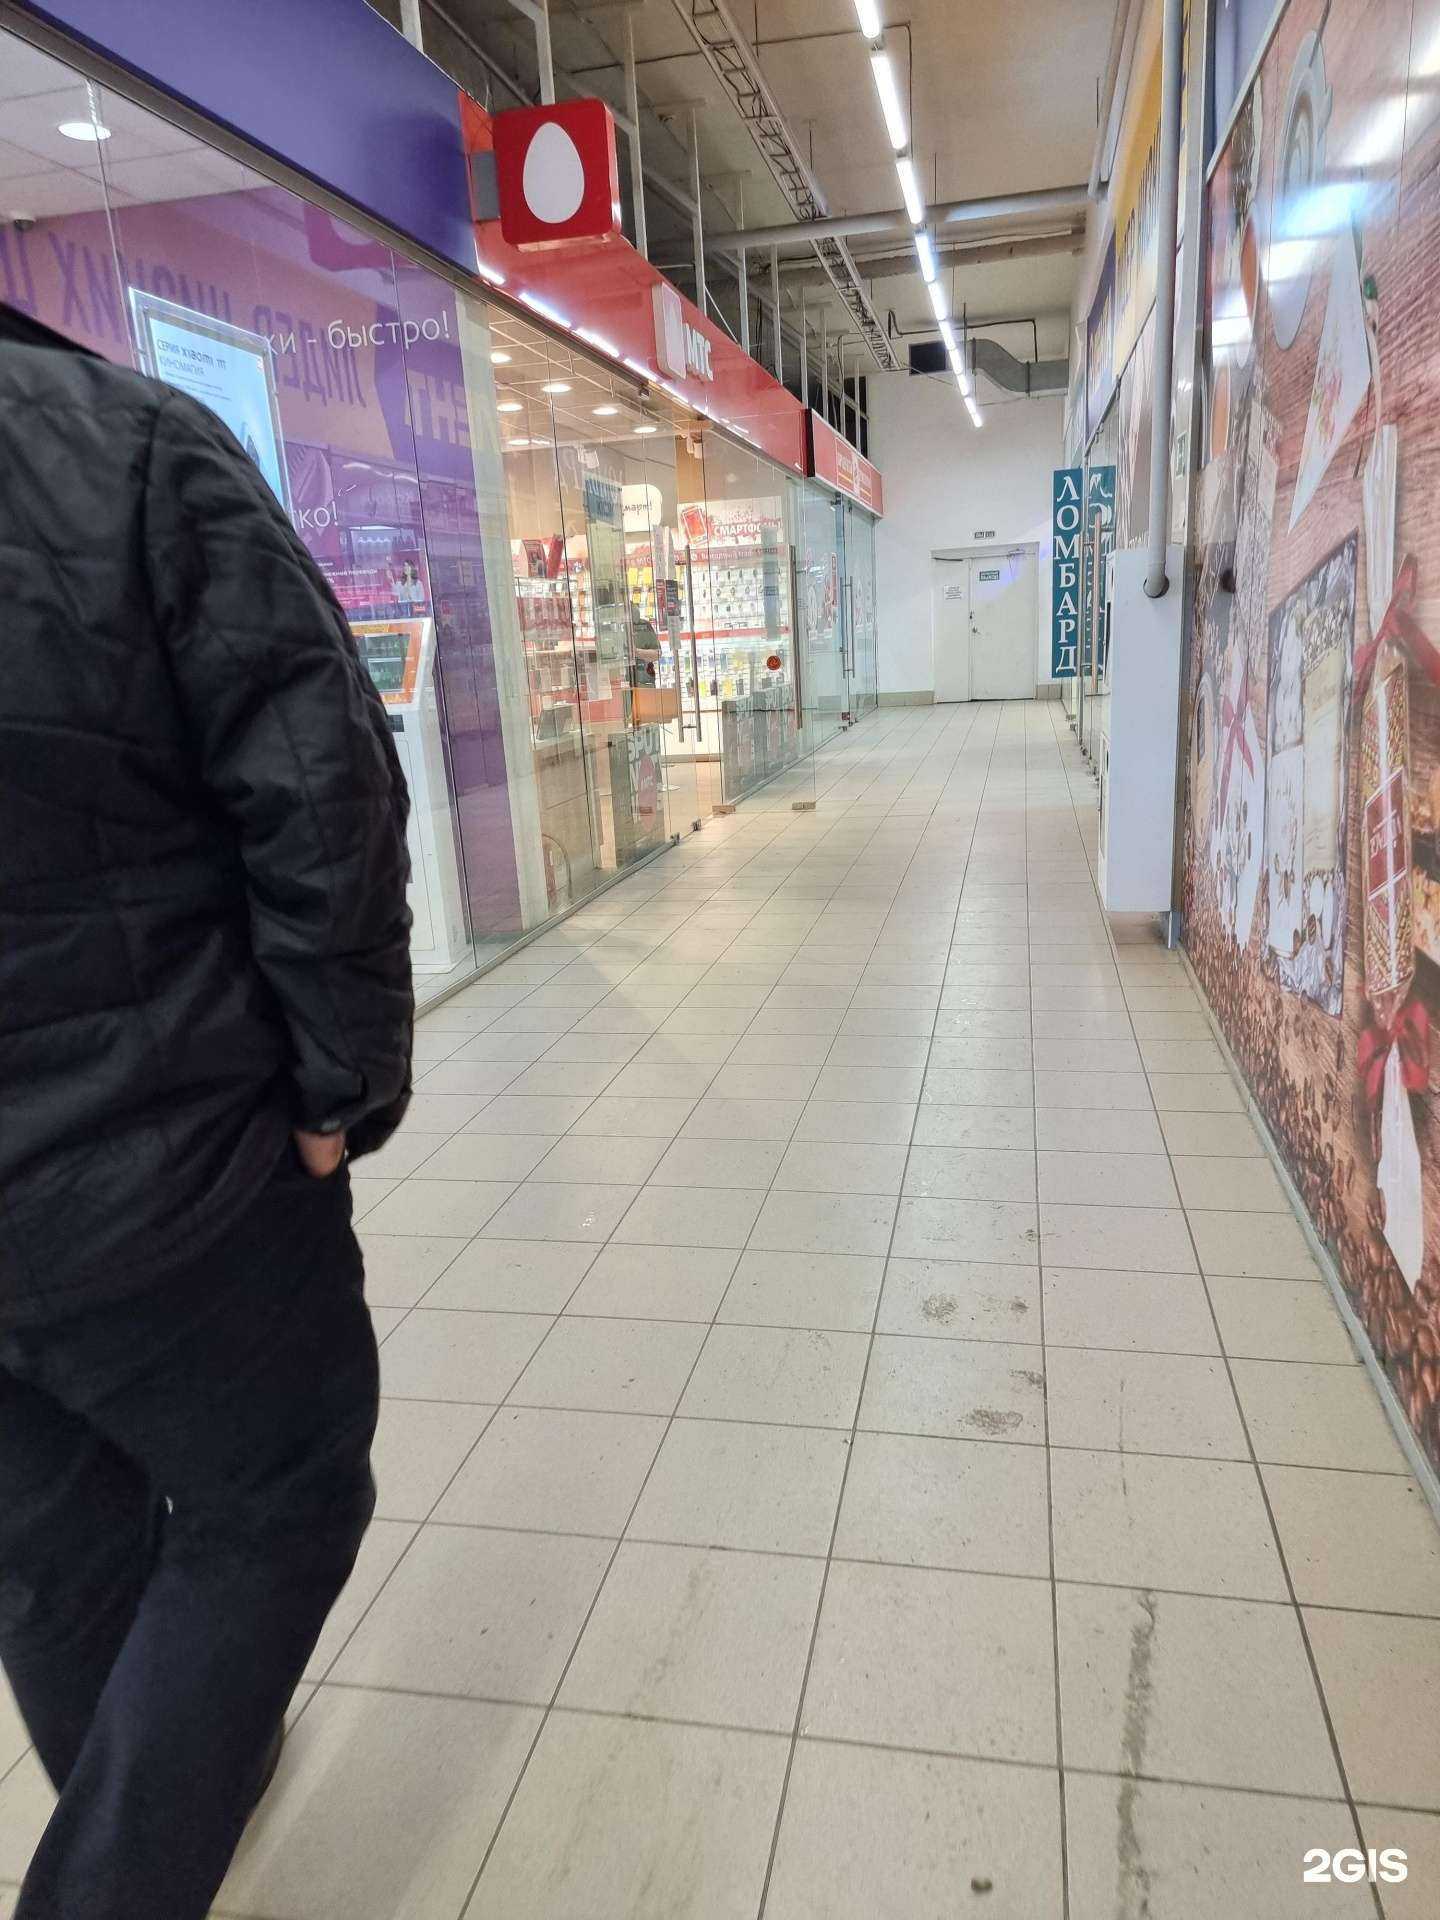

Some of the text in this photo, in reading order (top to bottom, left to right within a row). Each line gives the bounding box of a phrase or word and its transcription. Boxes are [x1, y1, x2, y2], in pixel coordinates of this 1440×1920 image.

[328, 310, 450, 350] быстро!
[682, 322, 714, 382] МТС
[293, 501, 338, 529] ко!
[1053, 475, 1081, 675] ЛОМБАРД
